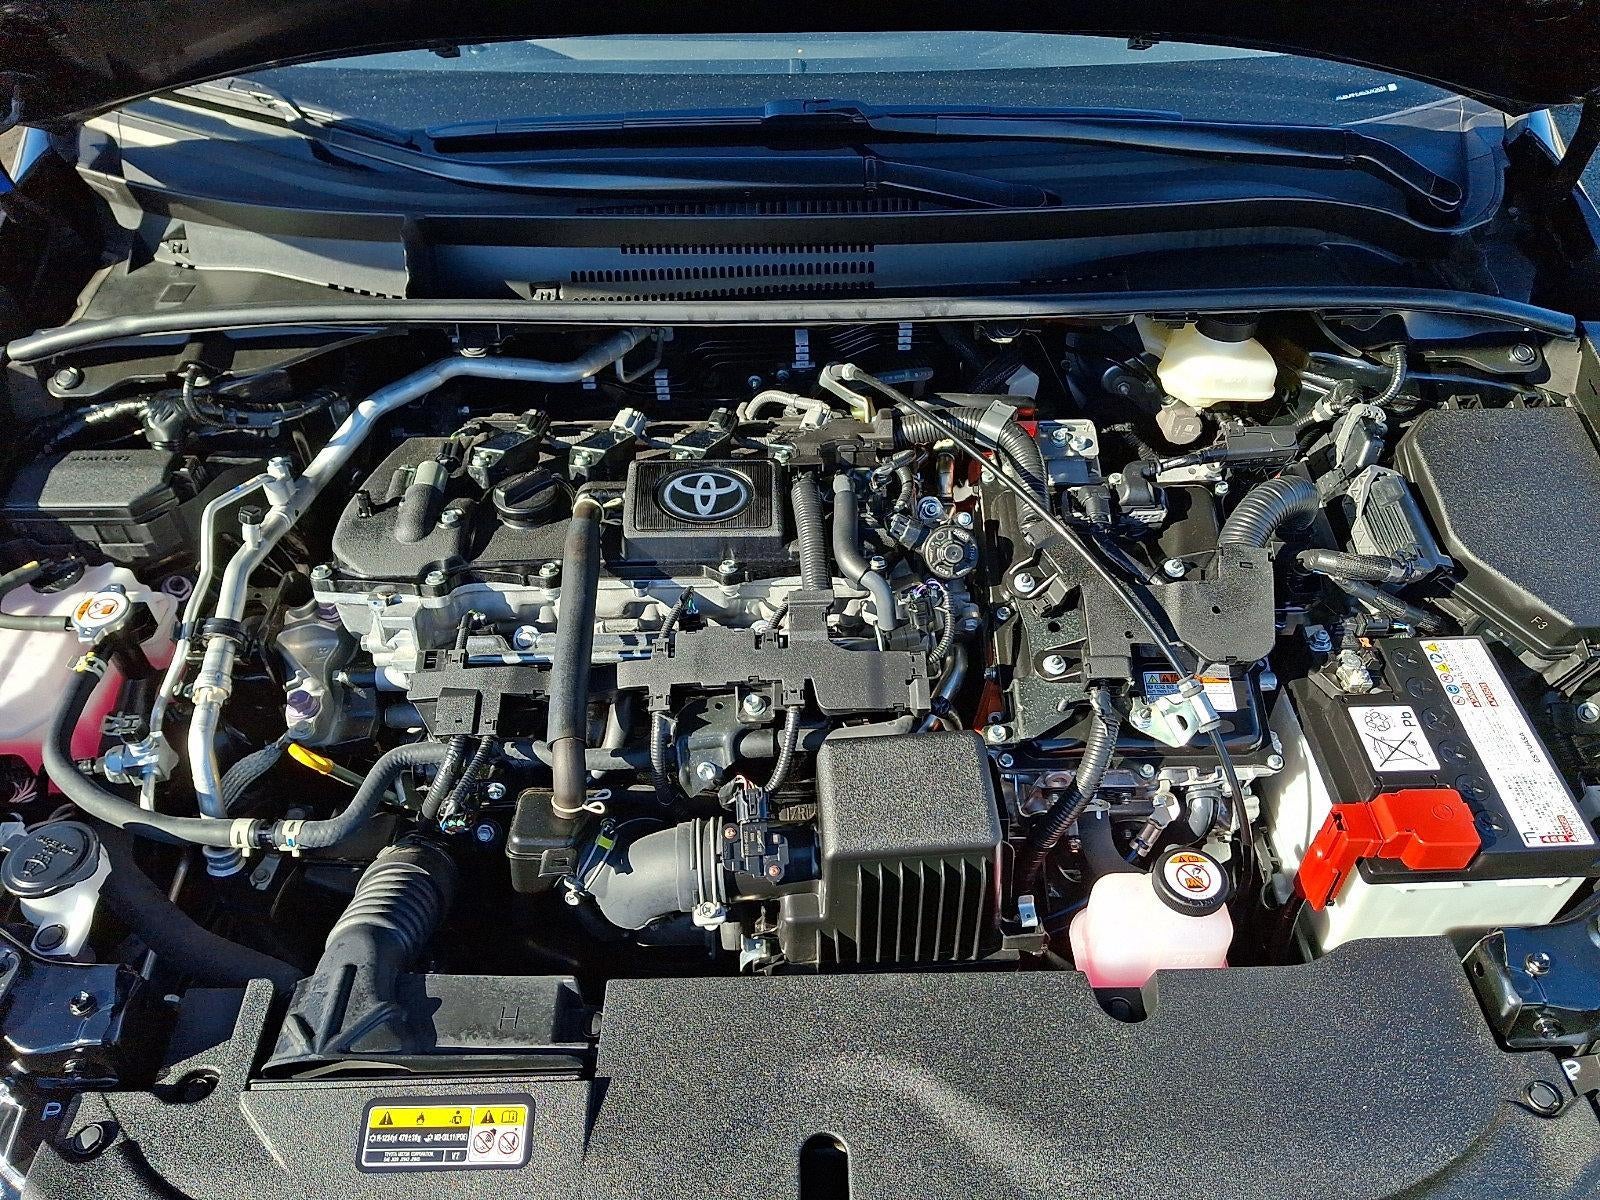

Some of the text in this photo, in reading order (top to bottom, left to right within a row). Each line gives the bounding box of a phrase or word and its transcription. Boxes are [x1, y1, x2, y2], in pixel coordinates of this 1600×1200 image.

[1530, 616, 1548, 630] F3
[1400, 712, 1416, 726] Pb
[500, 1006, 520, 1029] H
[1562, 1060, 1580, 1080] P
[41, 1102, 61, 1121] P
